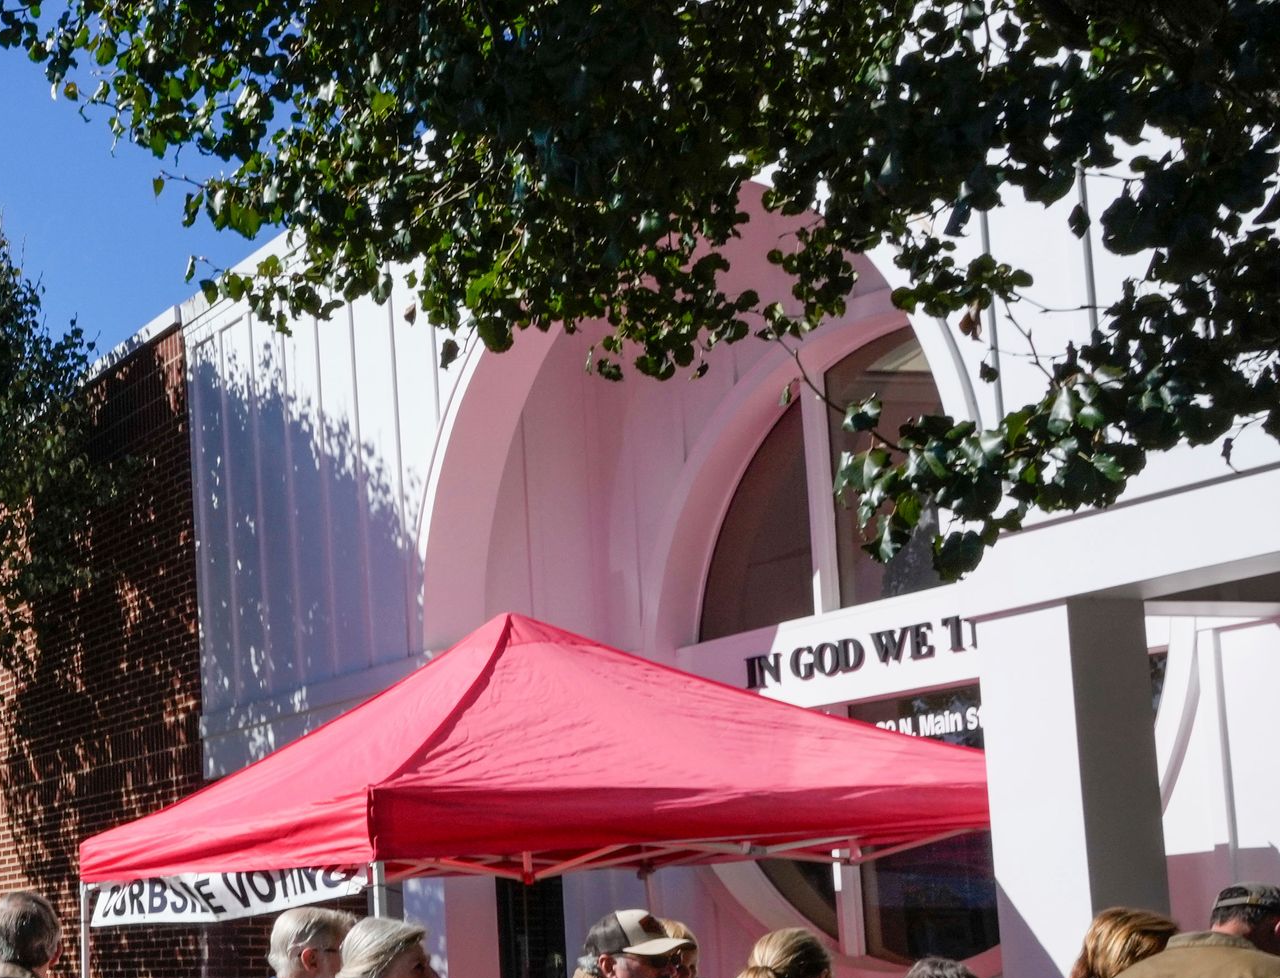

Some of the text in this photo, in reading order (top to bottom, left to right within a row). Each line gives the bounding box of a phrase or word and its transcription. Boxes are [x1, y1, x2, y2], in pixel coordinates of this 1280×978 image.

[744, 653, 782, 688] IN
[790, 637, 865, 681] GOD
[870, 622, 936, 666] WE
[919, 709, 963, 737] Main
